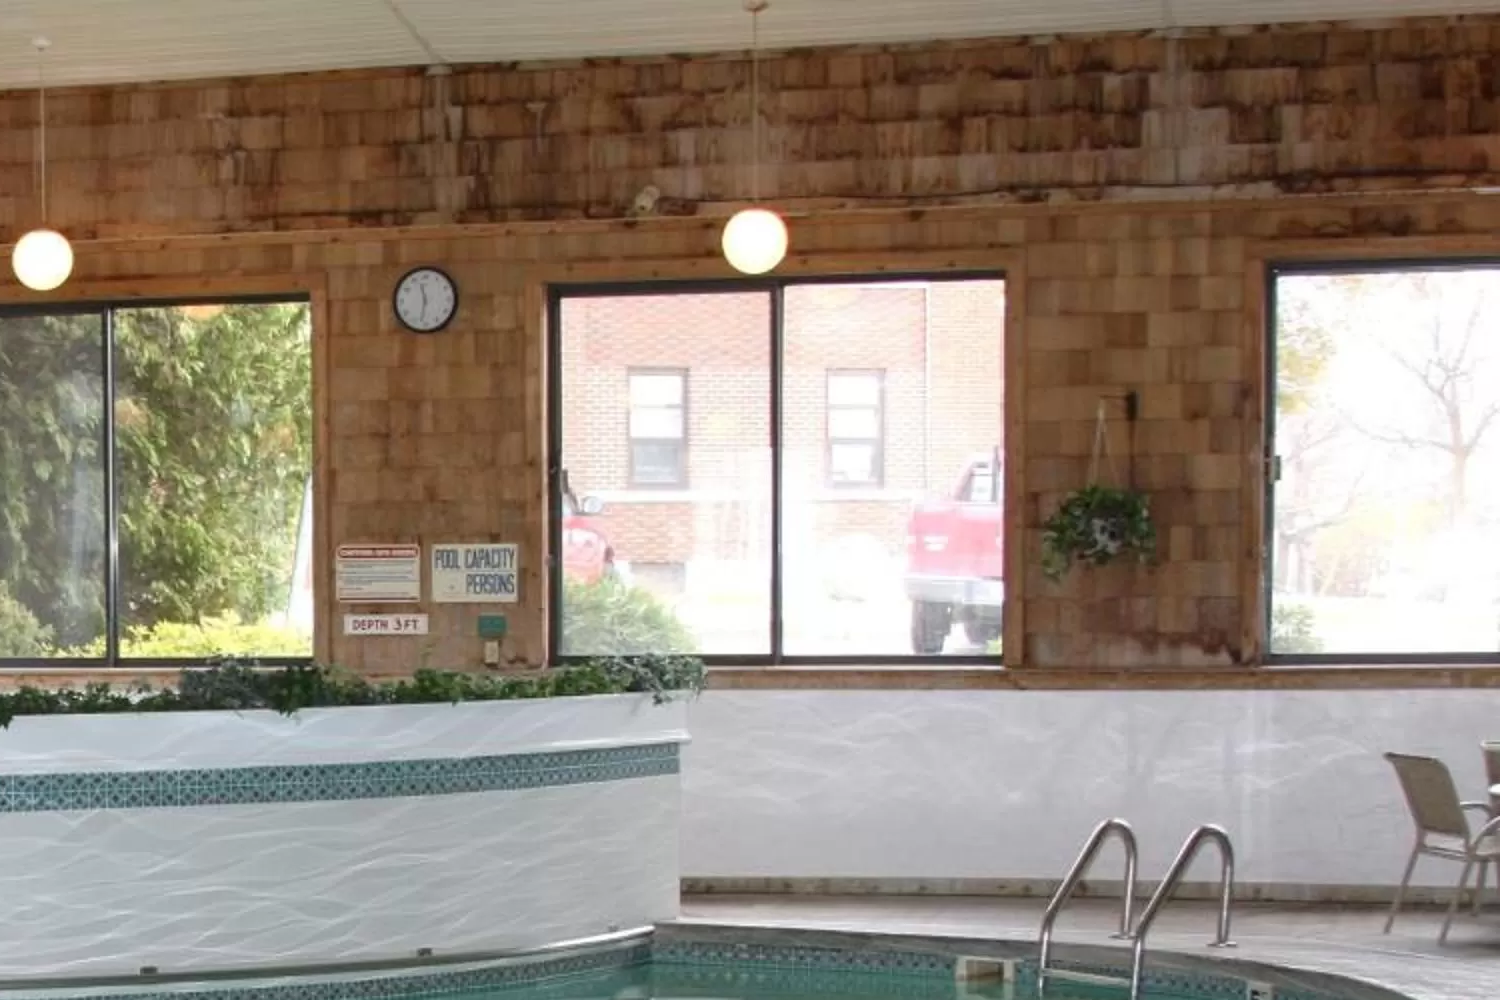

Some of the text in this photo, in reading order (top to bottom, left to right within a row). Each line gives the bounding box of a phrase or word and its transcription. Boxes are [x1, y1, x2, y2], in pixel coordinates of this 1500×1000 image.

[434, 549, 461, 569] POOL
[464, 547, 515, 569] CAPACITY
[466, 573, 515, 595] PERSONS
[351, 619, 389, 631] DEPTH
